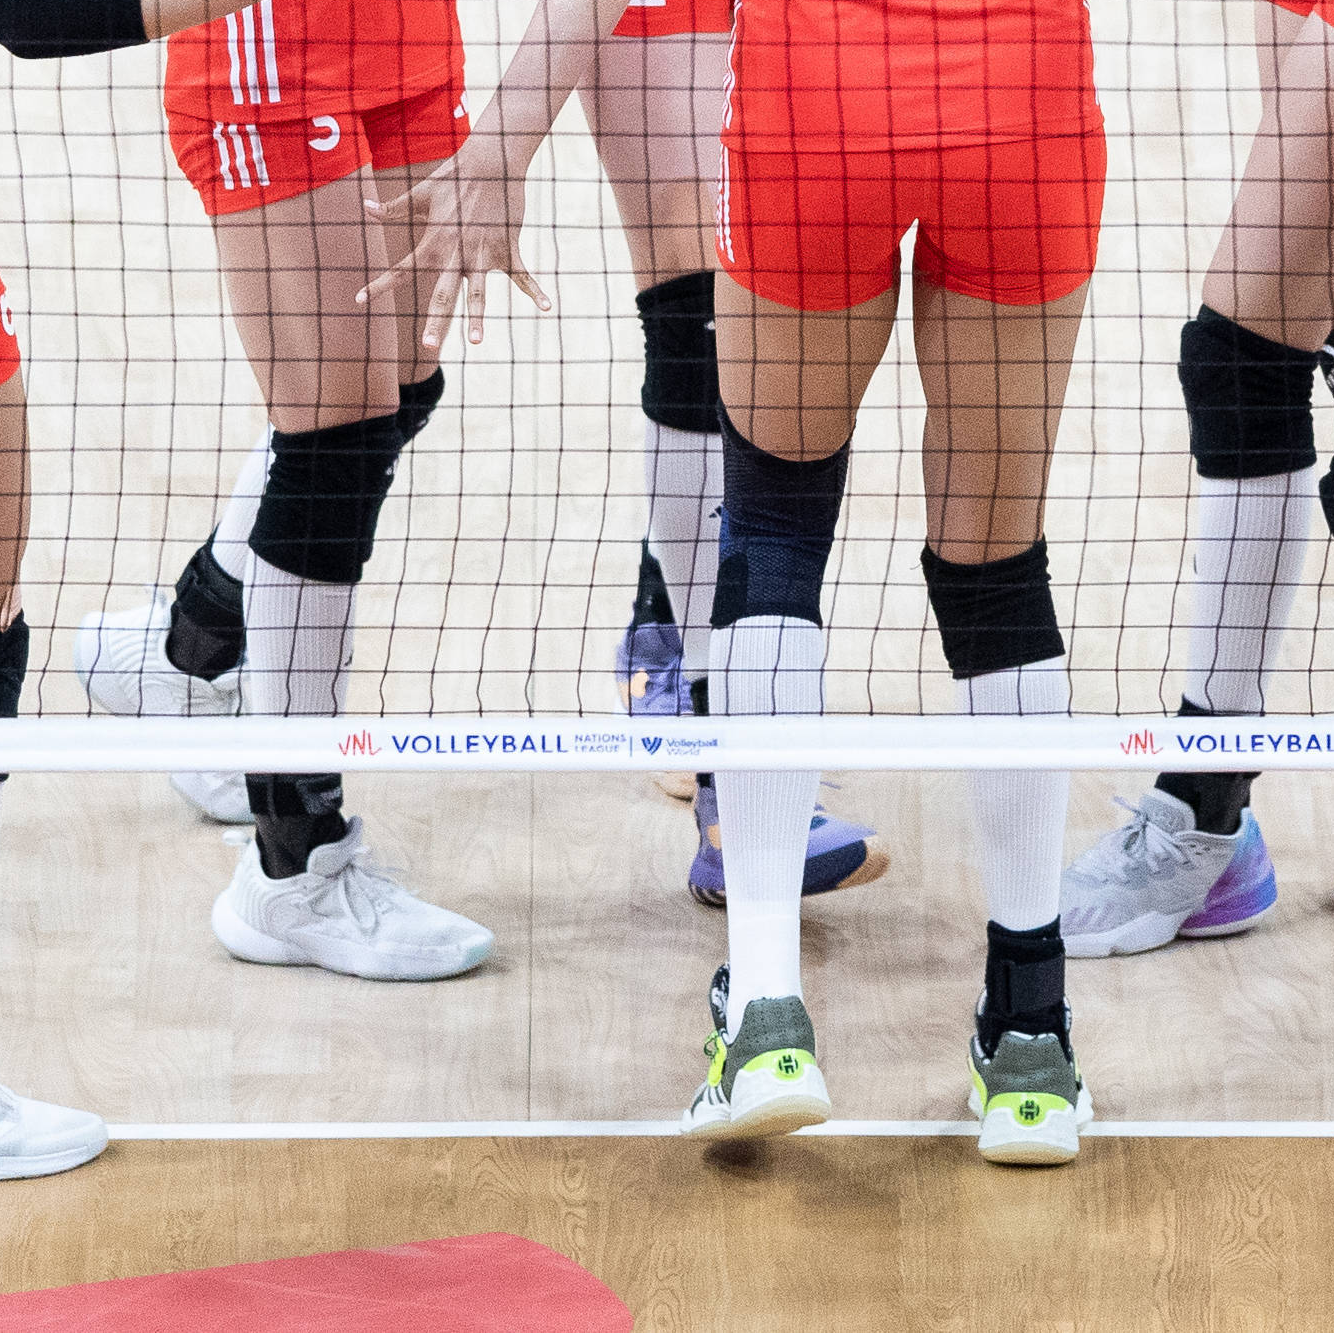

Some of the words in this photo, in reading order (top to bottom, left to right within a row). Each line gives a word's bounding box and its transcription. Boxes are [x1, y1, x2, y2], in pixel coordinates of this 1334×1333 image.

[338, 730, 381, 755] VNL
[392, 734, 568, 754] VOLLEYBALL
[574, 734, 626, 743] NATIONS
[666, 737, 718, 749] Volleyball
[1120, 729, 1163, 755] VNL
